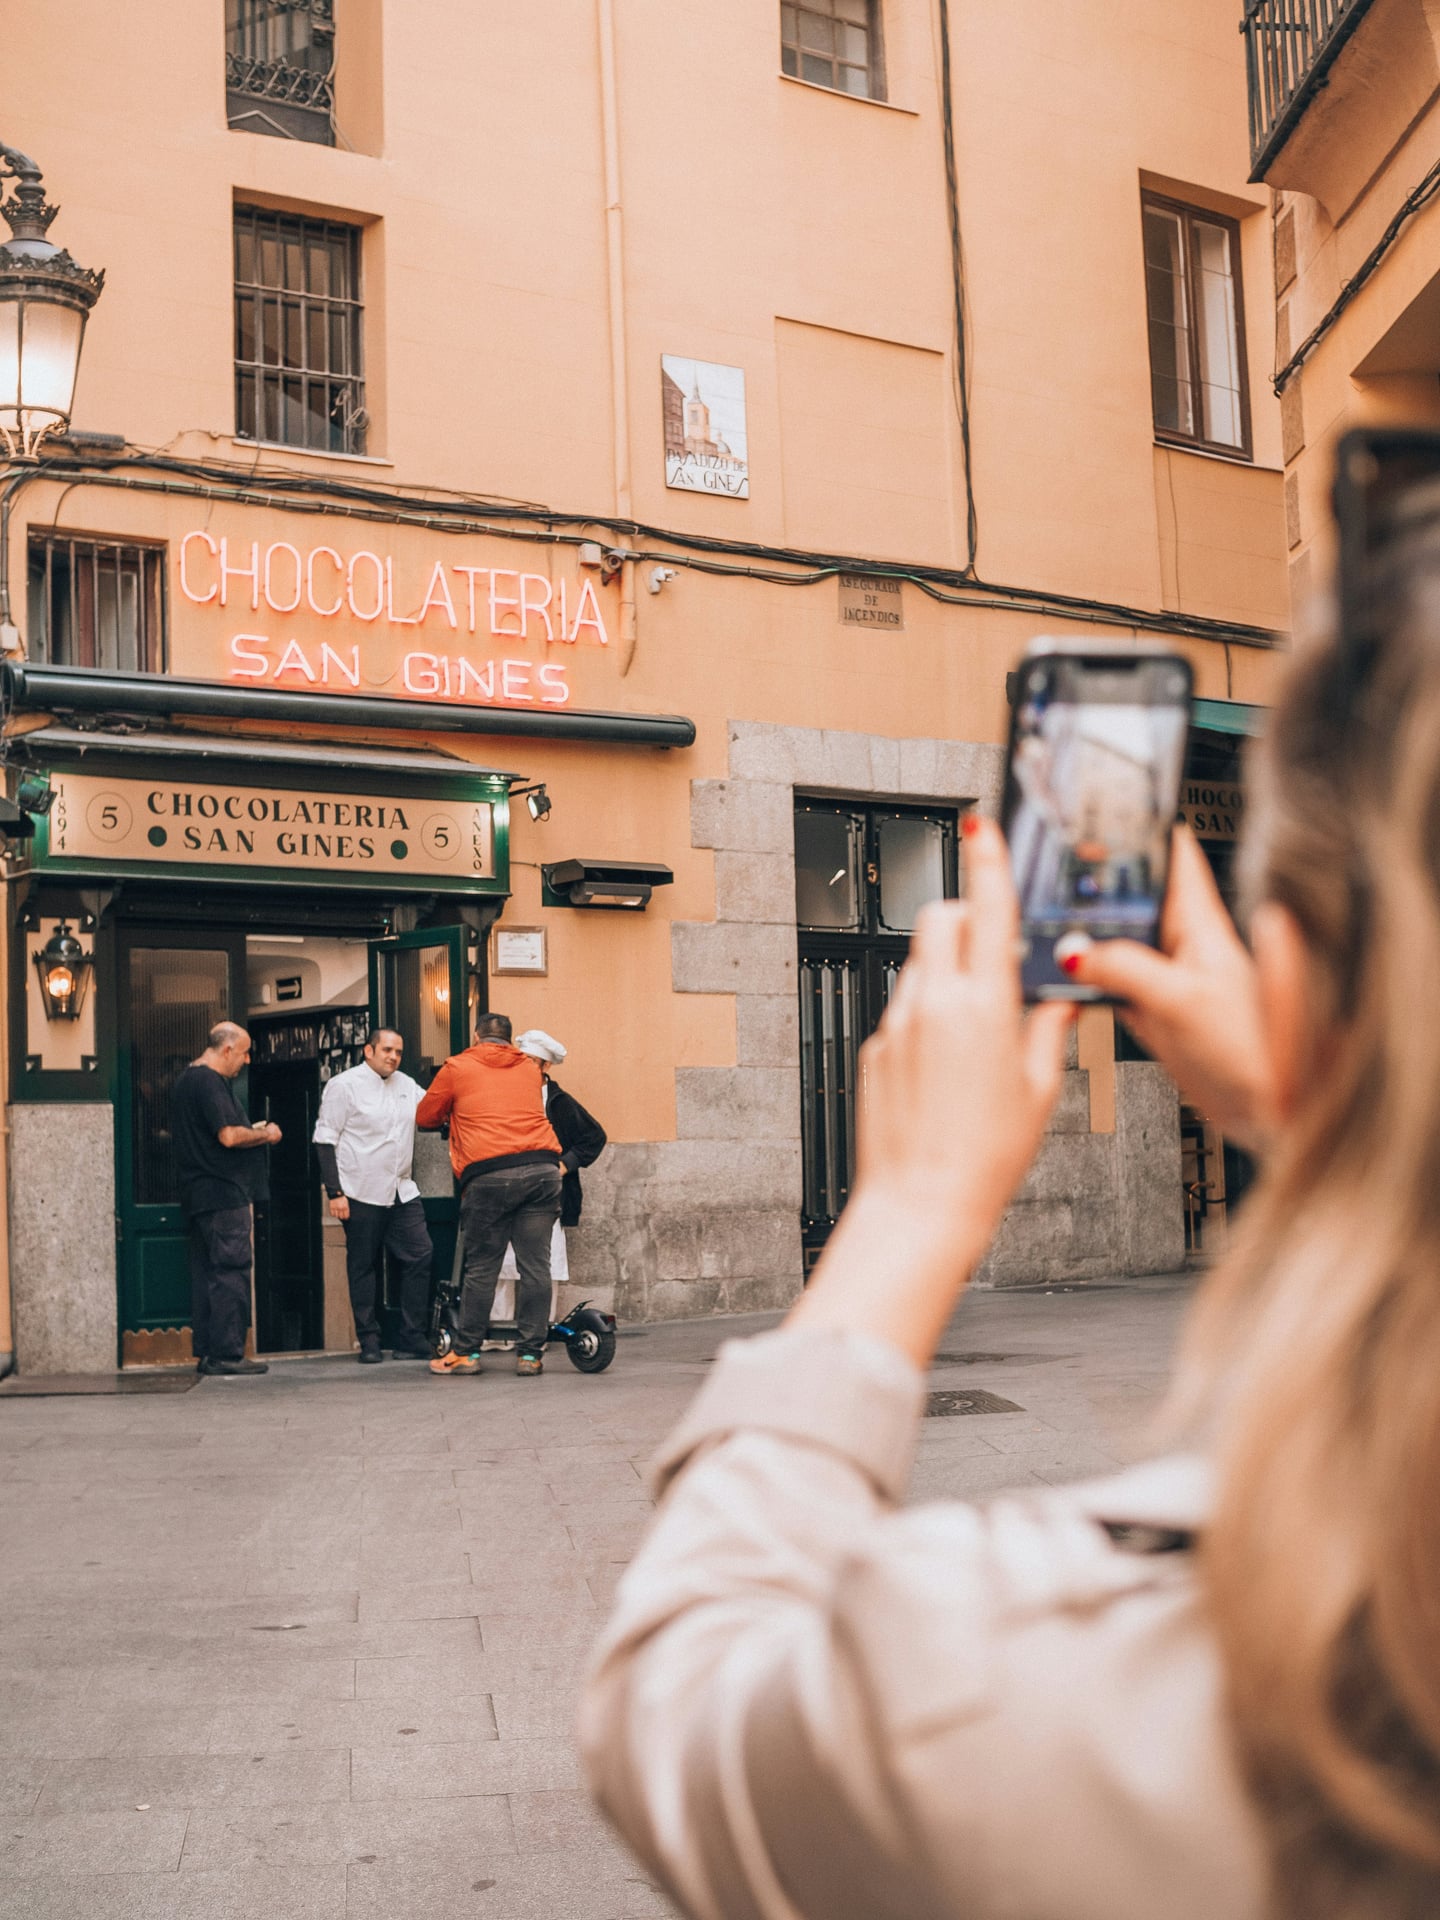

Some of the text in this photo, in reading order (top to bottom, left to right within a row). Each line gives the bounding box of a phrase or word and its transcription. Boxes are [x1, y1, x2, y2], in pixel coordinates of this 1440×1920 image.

[733, 459, 746, 472] DE
[668, 466, 749, 495] SAN GINES
[179, 530, 609, 645] CHOCOLATERIA
[864, 594, 879, 606] DE
[843, 607, 900, 625] INCENDIOS
[231, 633, 570, 703] SAN GINES
[57, 783, 67, 850] 1894
[101, 806, 118, 829] 5
[147, 791, 410, 831] CHOCOLATERIA
[1194, 812, 1235, 833] SAN
[184, 826, 375, 859] SAN GINES
[434, 826, 449, 848] 5
[472, 808, 483, 871] ANEXO
[867, 863, 878, 884] 5
